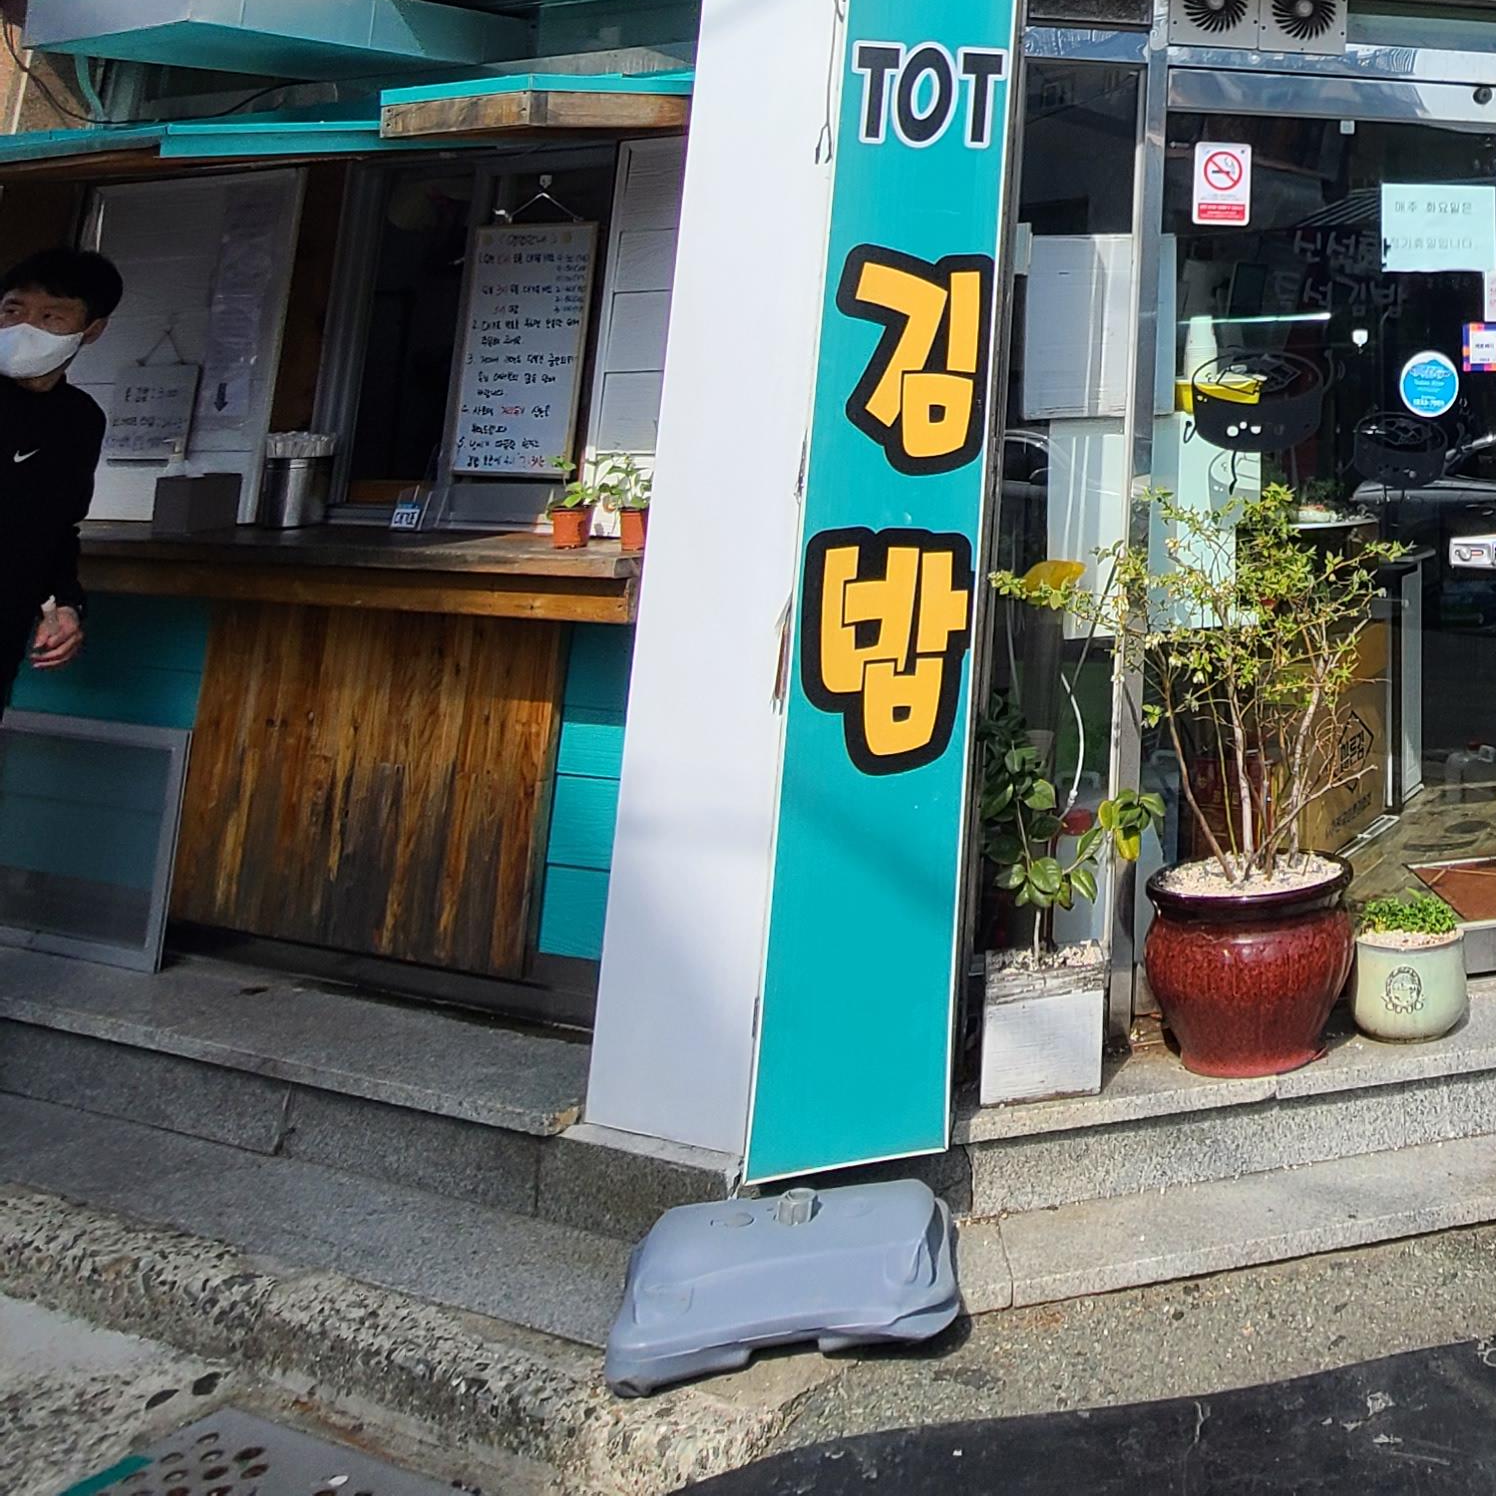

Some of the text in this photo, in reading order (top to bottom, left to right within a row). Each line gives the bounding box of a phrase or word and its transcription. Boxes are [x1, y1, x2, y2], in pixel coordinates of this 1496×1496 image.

[852, 41, 1007, 148] TOT
[1395, 201, 1472, 215] 매주 화요일은
